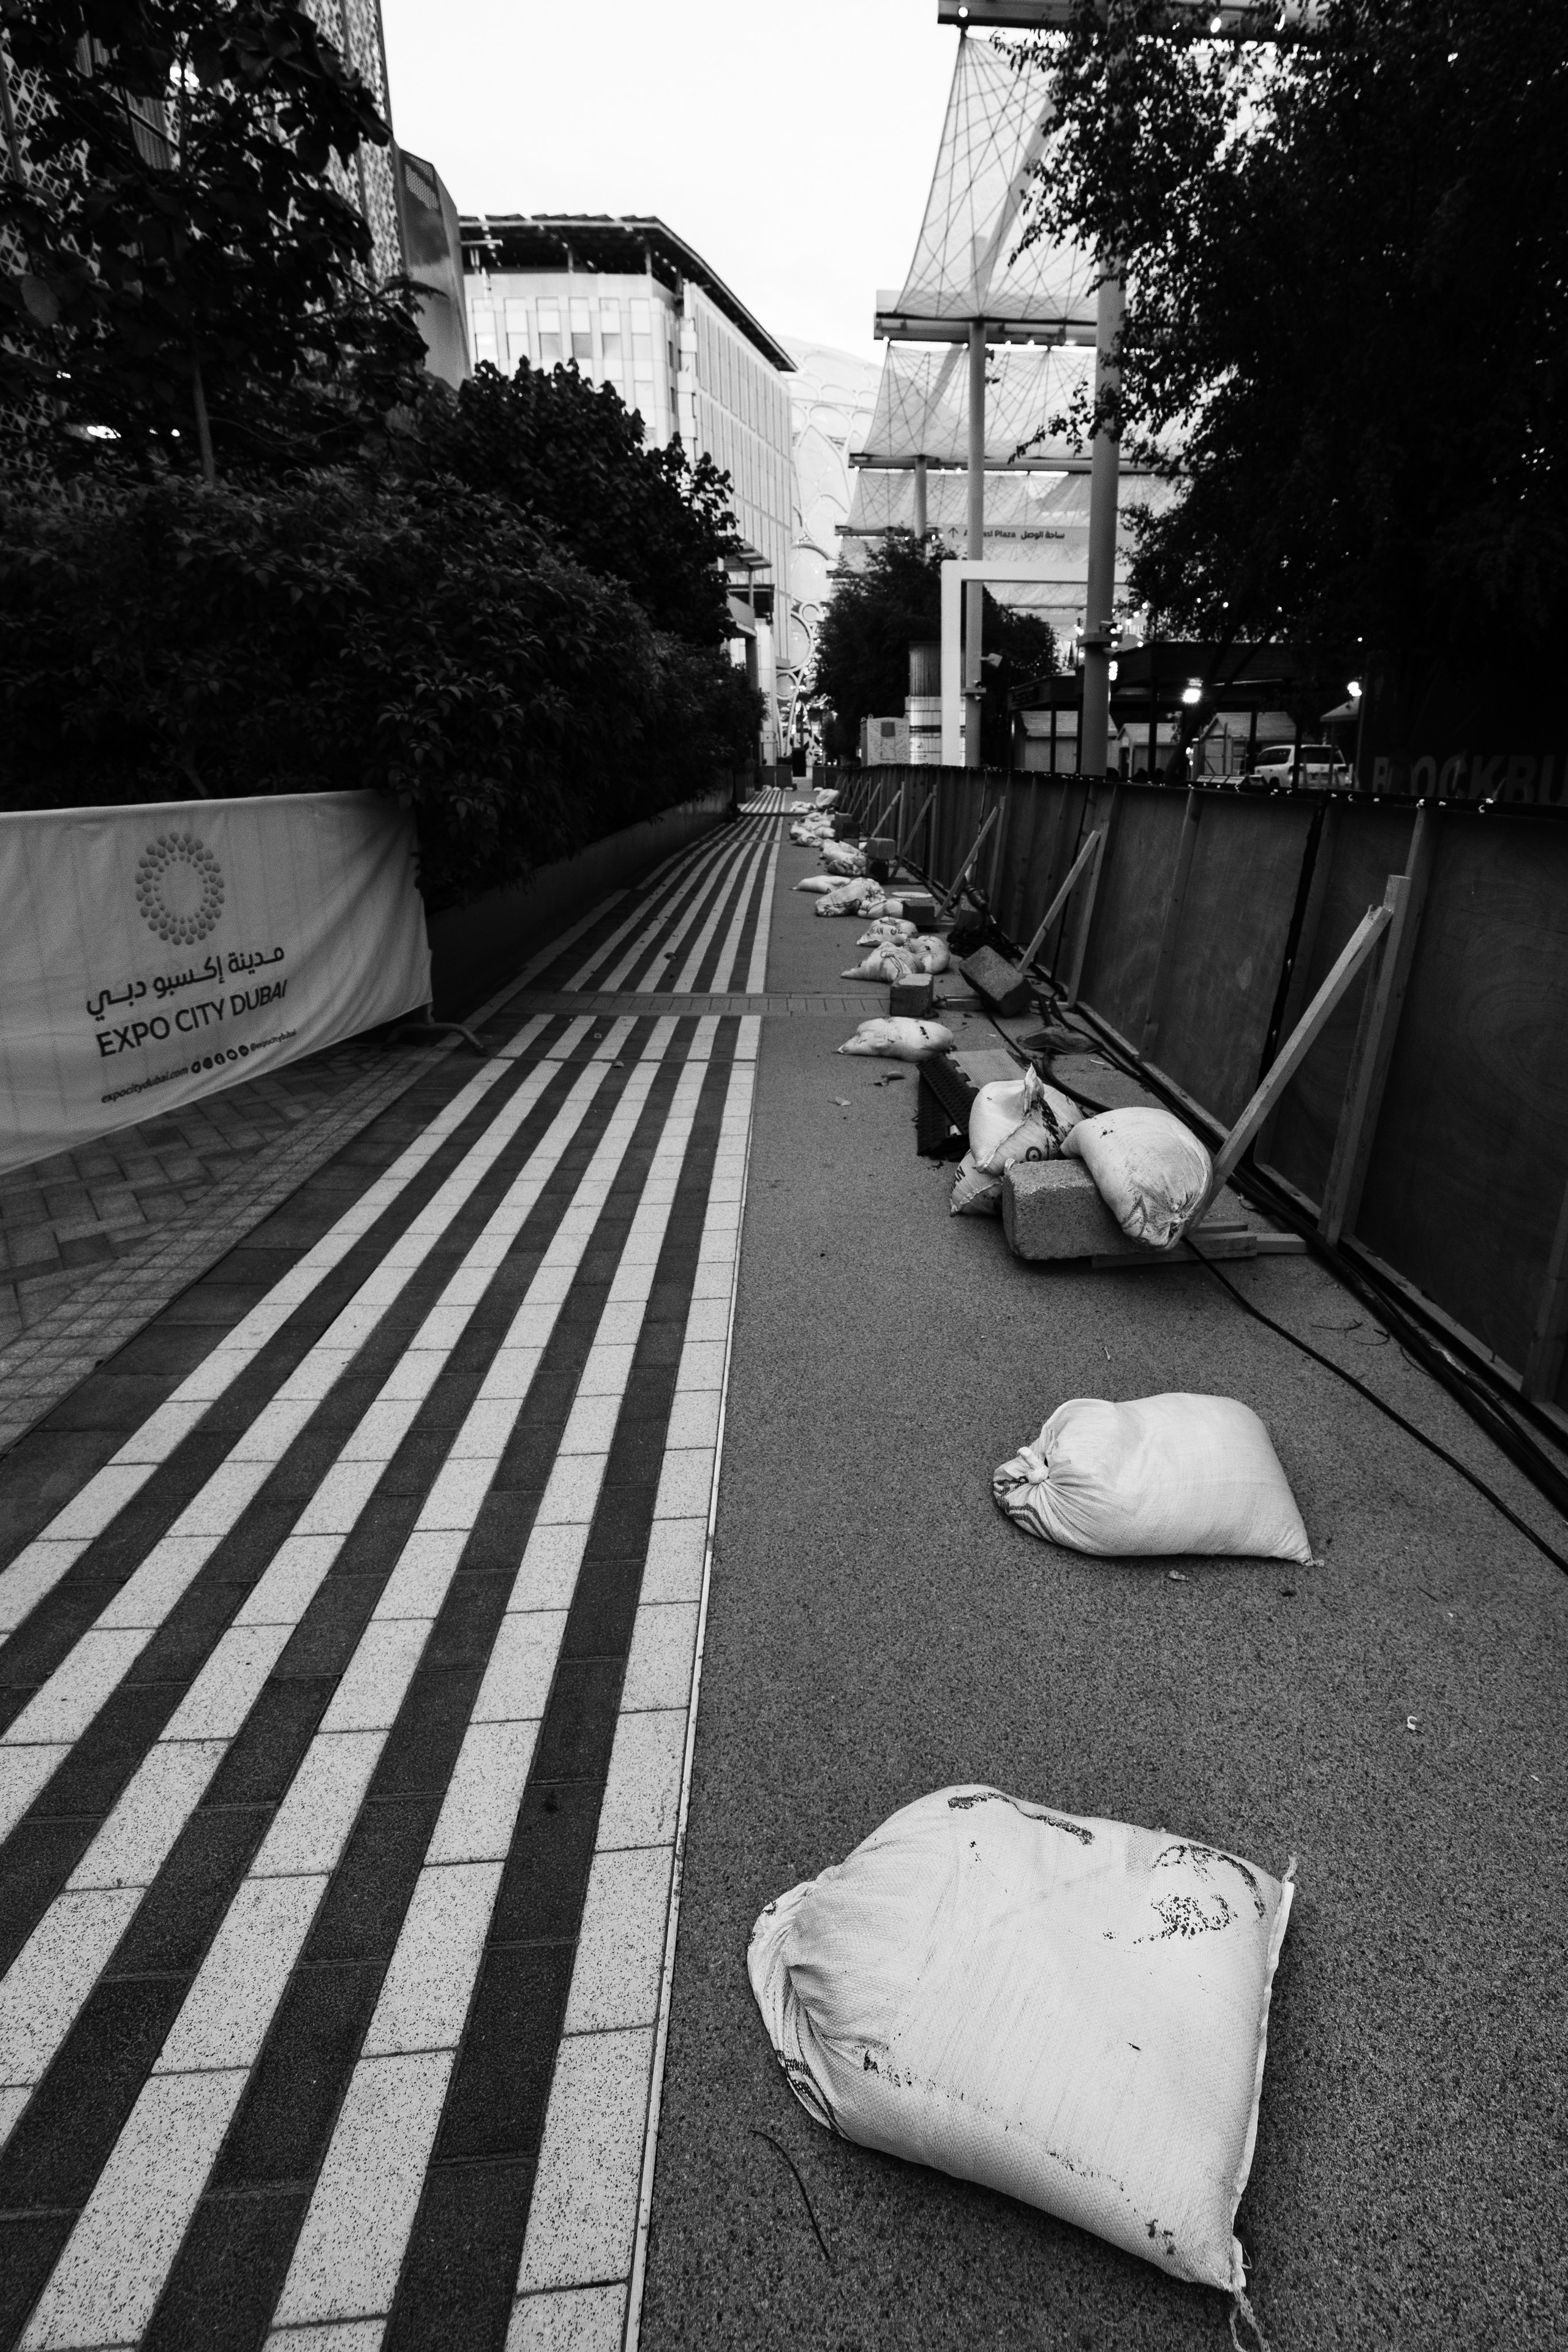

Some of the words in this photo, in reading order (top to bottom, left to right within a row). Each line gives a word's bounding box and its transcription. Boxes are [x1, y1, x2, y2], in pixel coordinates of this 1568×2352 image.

[995, 529, 1016, 538] Plaza
[1020, 530, 1044, 540] الوصل
[1045, 530, 1065, 539] ساحة
[1371, 753, 1568, 806] BOCKBU
[153, 955, 225, 999] إكسبو
[228, 946, 285, 975] مدينة
[86, 980, 147, 1022] دبي
[96, 1016, 171, 1058] EXPO
[175, 998, 225, 1032] CITY
[229, 979, 288, 1016] DUBAI
[100, 1067, 189, 1104] expocitydubai.com
